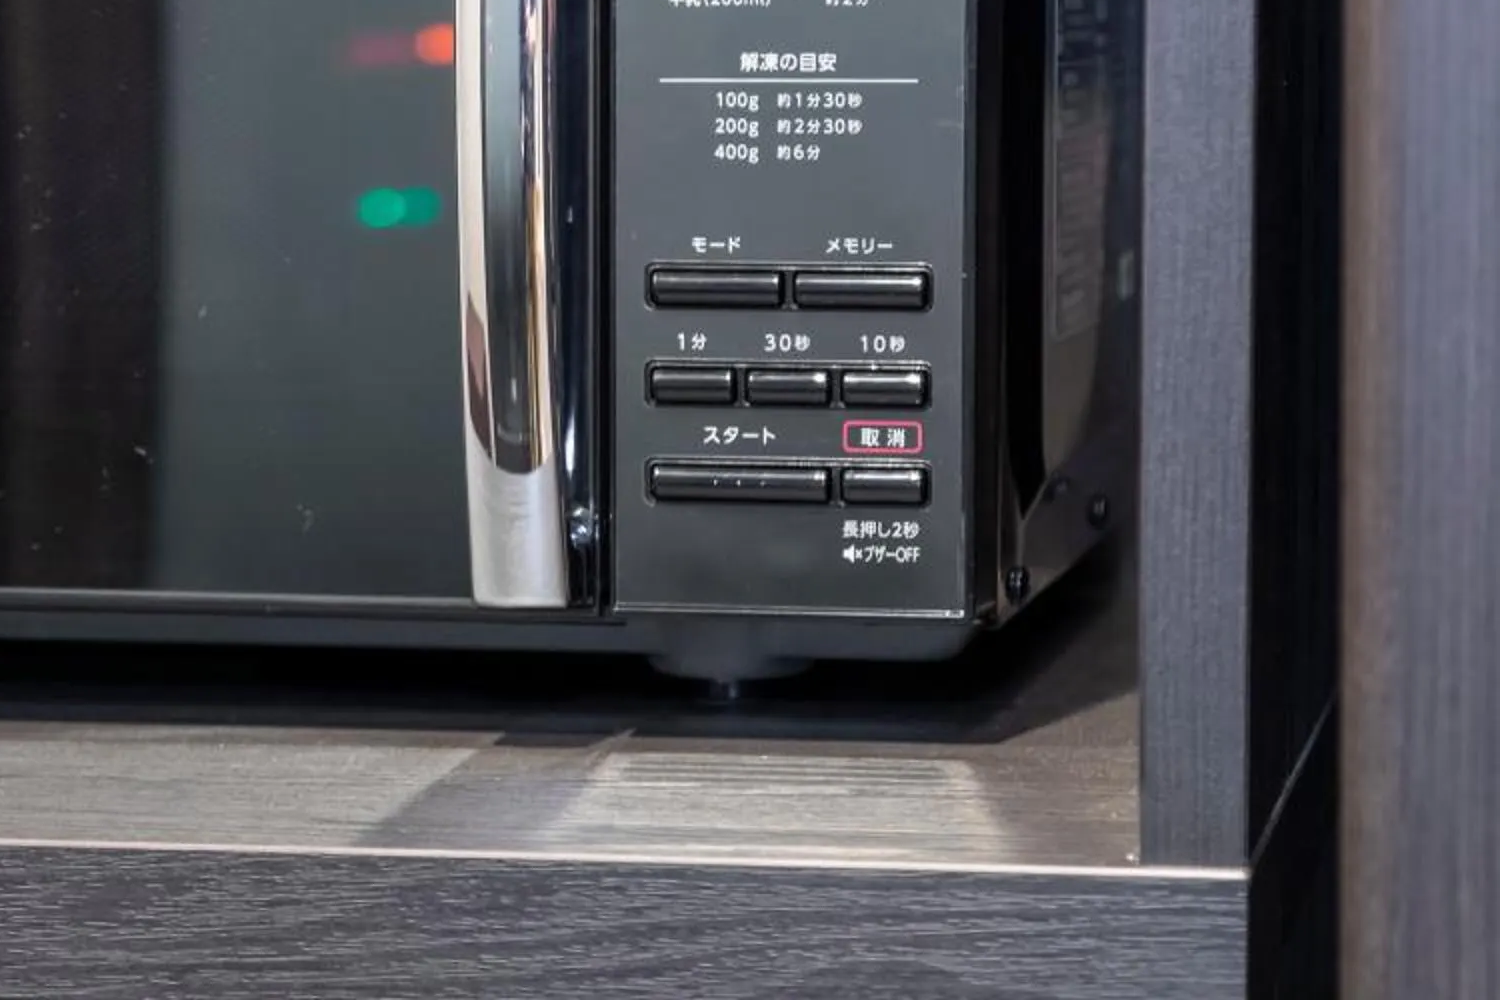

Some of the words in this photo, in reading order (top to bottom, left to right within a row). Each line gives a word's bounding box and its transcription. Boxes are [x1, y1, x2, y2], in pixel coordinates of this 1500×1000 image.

[740, 52, 837, 72] 解凍の目安
[715, 92, 760, 112] 100g
[715, 118, 760, 137] 200g
[714, 143, 760, 164] 400g
[777, 145, 821, 161] 約6分
[691, 236, 741, 254] モード
[826, 237, 893, 254] メモリー
[677, 333, 707, 351] 1分
[764, 333, 811, 353] 30秒
[860, 335, 906, 353] 10秒
[703, 426, 777, 446] スタート
[842, 520, 920, 539] 長押し2秒
